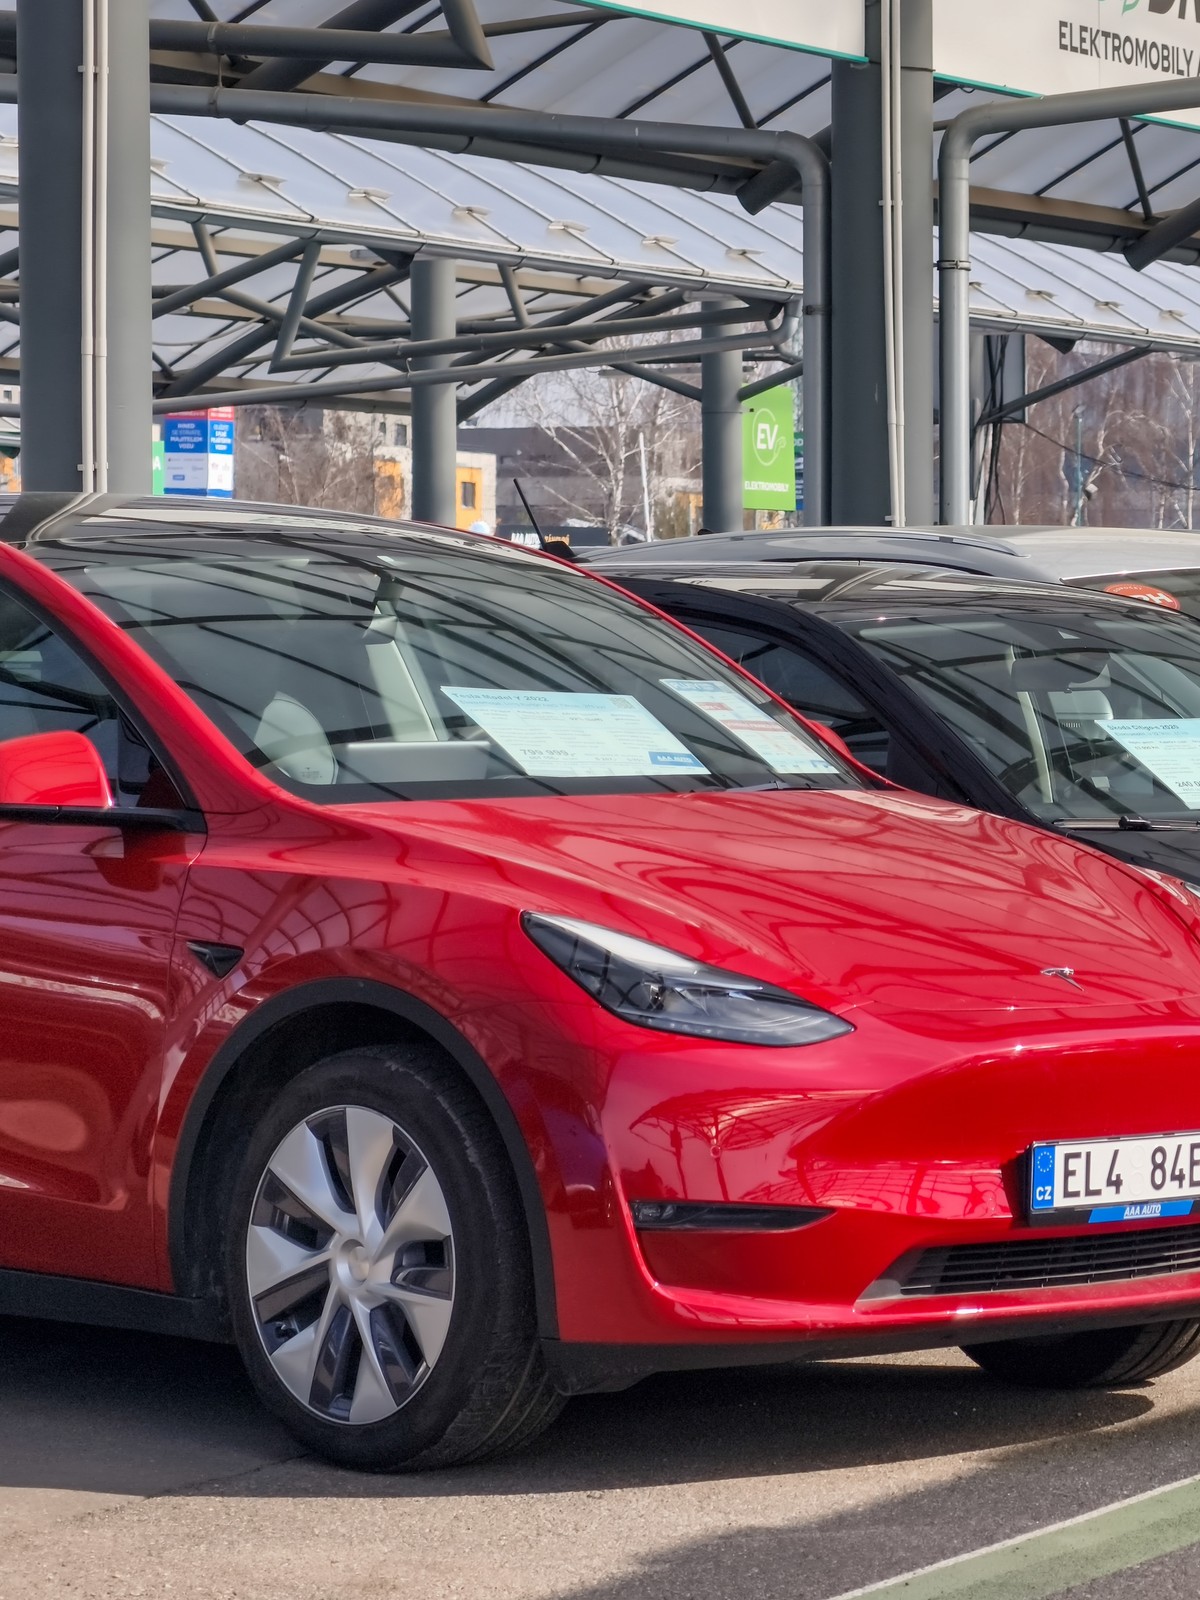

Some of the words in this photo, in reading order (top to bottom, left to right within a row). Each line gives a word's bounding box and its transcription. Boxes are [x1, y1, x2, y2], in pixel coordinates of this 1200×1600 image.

[1059, 20, 1193, 77] ELEKTROMOBILY
[757, 423, 779, 450] EV
[744, 480, 789, 492] ELEKTROMOBILY
[1036, 1185, 1052, 1201] CZ
[1063, 1148, 1124, 1199] EL4
[1124, 1205, 1141, 1217] AAA
[1142, 1203, 1162, 1216] AUTO
